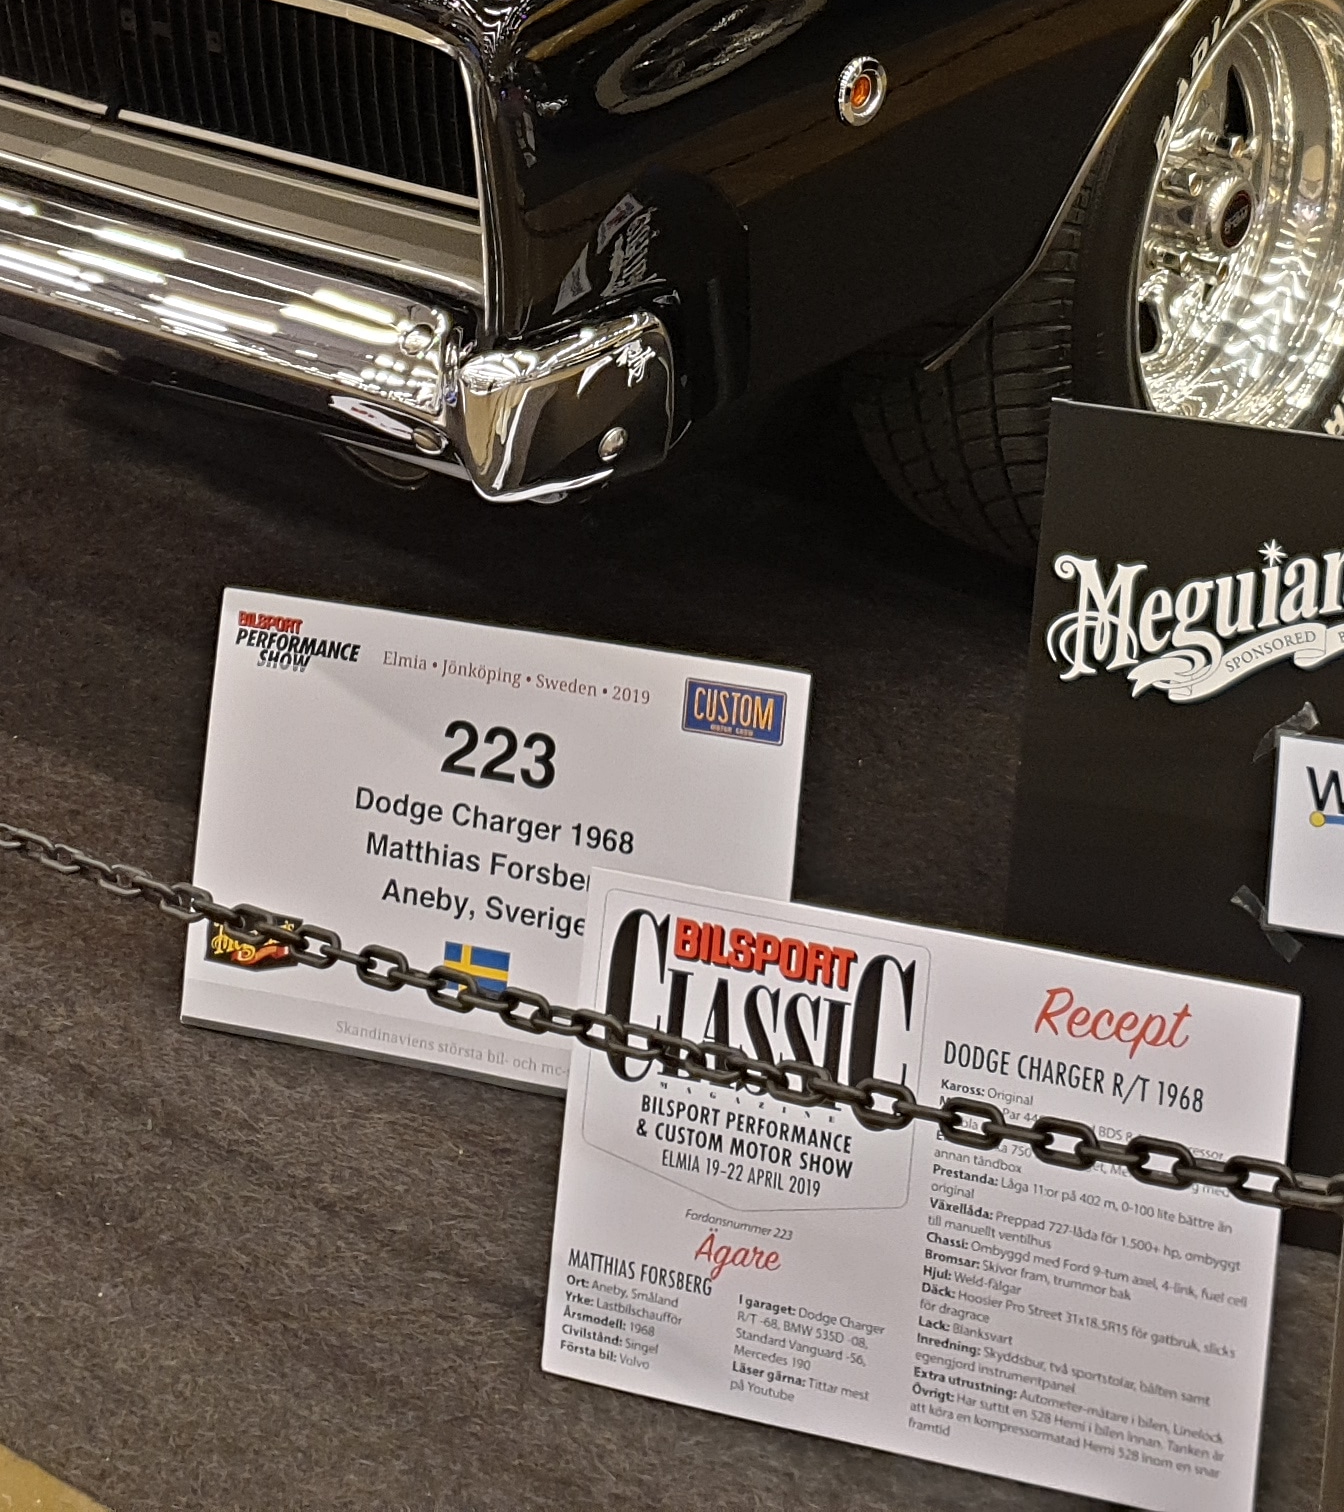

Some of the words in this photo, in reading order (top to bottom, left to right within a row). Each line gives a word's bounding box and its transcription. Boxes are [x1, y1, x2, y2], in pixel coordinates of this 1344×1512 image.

[239, 611, 303, 634] BILSPORT
[236, 628, 361, 662] PERFORMANCE
[1224, 630, 1317, 673] SPONSORED
[257, 649, 310, 672] SHOW
[382, 650, 426, 670] Elmia
[440, 658, 522, 688] Jönköping
[535, 673, 596, 697] Sweden
[611, 685, 650, 704] 2019
[694, 687, 775, 731] CUSTOM
[440, 720, 557, 789] 223
[355, 785, 443, 825] Dodge
[451, 801, 562, 843] Charger
[571, 822, 634, 855] 1968
[365, 830, 480, 872] Matthias
[489, 851, 591, 894] Forsbe
[484, 894, 584, 939] Sverige
[674, 917, 858, 989] BILSPORT
[604, 908, 917, 1130] CLASSIC
[336, 1020, 434, 1051] Skandinaviens
[438, 1040, 483, 1061] största
[513, 1056, 537, 1072] och
[943, 1039, 1011, 1076] DODGE
[1017, 1054, 1104, 1094] CHARGER
[940, 1078, 985, 1097] Kaross:
[640, 1093, 721, 1127] BILSPORT
[725, 1110, 852, 1154] PERFORMANCE
[654, 1121, 723, 1153] CUSTOM
[729, 1136, 792, 1167] MOTOR
[798, 1150, 853, 1179] SHOW
[661, 1148, 700, 1173] ELMIA
[746, 1166, 784, 1191] APRIL
[932, 1163, 998, 1186] Prestanda:
[929, 1196, 993, 1220] Växellåda:
[925, 1231, 968, 1250] Chassi:
[924, 1247, 980, 1269] Bromsar:
[566, 1273, 589, 1288] Ort:
[567, 1247, 636, 1280] MATTHIAS
[639, 1264, 713, 1296] FORSBERG
[922, 1264, 952, 1280] Hjul:
[565, 1289, 594, 1306] Yrke:
[921, 1281, 956, 1299] Däck:
[562, 1303, 626, 1331] Årsmodell:
[744, 1297, 796, 1316] garaget:
[561, 1323, 623, 1347] Civilstånd:
[918, 1314, 950, 1332] Lack:
[598, 1346, 617, 1362] bil:
[916, 1331, 981, 1357] Inredning:
[911, 1381, 954, 1403] Övrigt:
[947, 1375, 1017, 1401] utrustning:
